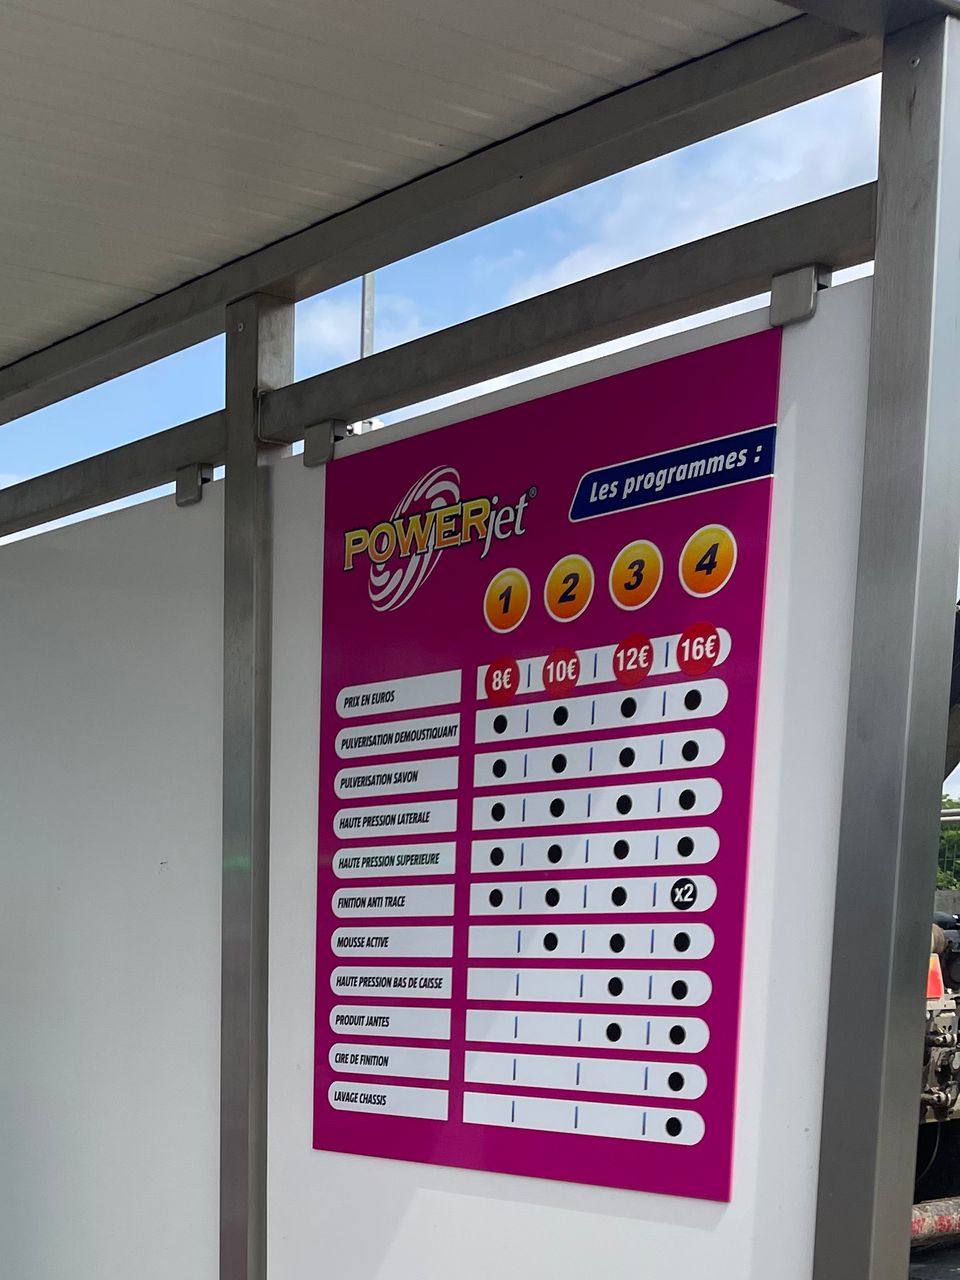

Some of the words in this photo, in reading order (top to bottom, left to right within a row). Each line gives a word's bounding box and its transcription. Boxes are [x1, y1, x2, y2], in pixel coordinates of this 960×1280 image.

[590, 481, 617, 503] Les
[623, 448, 748, 499] programmes
[754, 445, 762, 463] :
[499, 586, 512, 614] 1
[558, 573, 579, 603] 2
[624, 559, 644, 591] 3
[695, 543, 719, 575] 4
[492, 668, 512, 691] 8€
[547, 658, 577, 683] 10€
[617, 645, 650, 671] 12€
[681, 635, 716, 662] 16€
[344, 696, 360, 708] PRIX
[361, 694, 370, 706] EN
[372, 690, 395, 705] EUROS
[341, 733, 393, 750] PULVERISATION
[395, 725, 458, 743] DEMOUSTIQUANT
[340, 773, 393, 789] PULVERISATION
[394, 770, 418, 784] SAVON
[340, 817, 361, 829] HAUTE
[362, 814, 396, 827] PRESSION
[397, 811, 431, 824] LATERALE
[339, 857, 360, 869] HAUTE
[361, 855, 395, 868] PRESSION
[396, 853, 440, 866] SUPERIEURE
[338, 897, 366, 908] FINITION
[367, 897, 383, 907] ANTI
[385, 896, 406, 907] TRACE
[674, 884, 693, 902] x2
[337, 937, 365, 947] MOUSSE
[366, 937, 389, 947] ACTIVE
[336, 976, 358, 987] HAUTE
[359, 977, 392, 988] PRESSION
[393, 977, 406, 988] BAS
[408, 977, 418, 988] DE
[419, 978, 443, 988] CAISSE
[336, 1015, 365, 1026] PRODUIT
[365, 1016, 389, 1027] JANTES
[335, 1053, 349, 1064] CIRE
[350, 1054, 359, 1064] DE
[360, 1054, 389, 1066] FINITION
[334, 1091, 358, 1103] LAVAGE
[360, 1093, 386, 1105] CHASSIS
